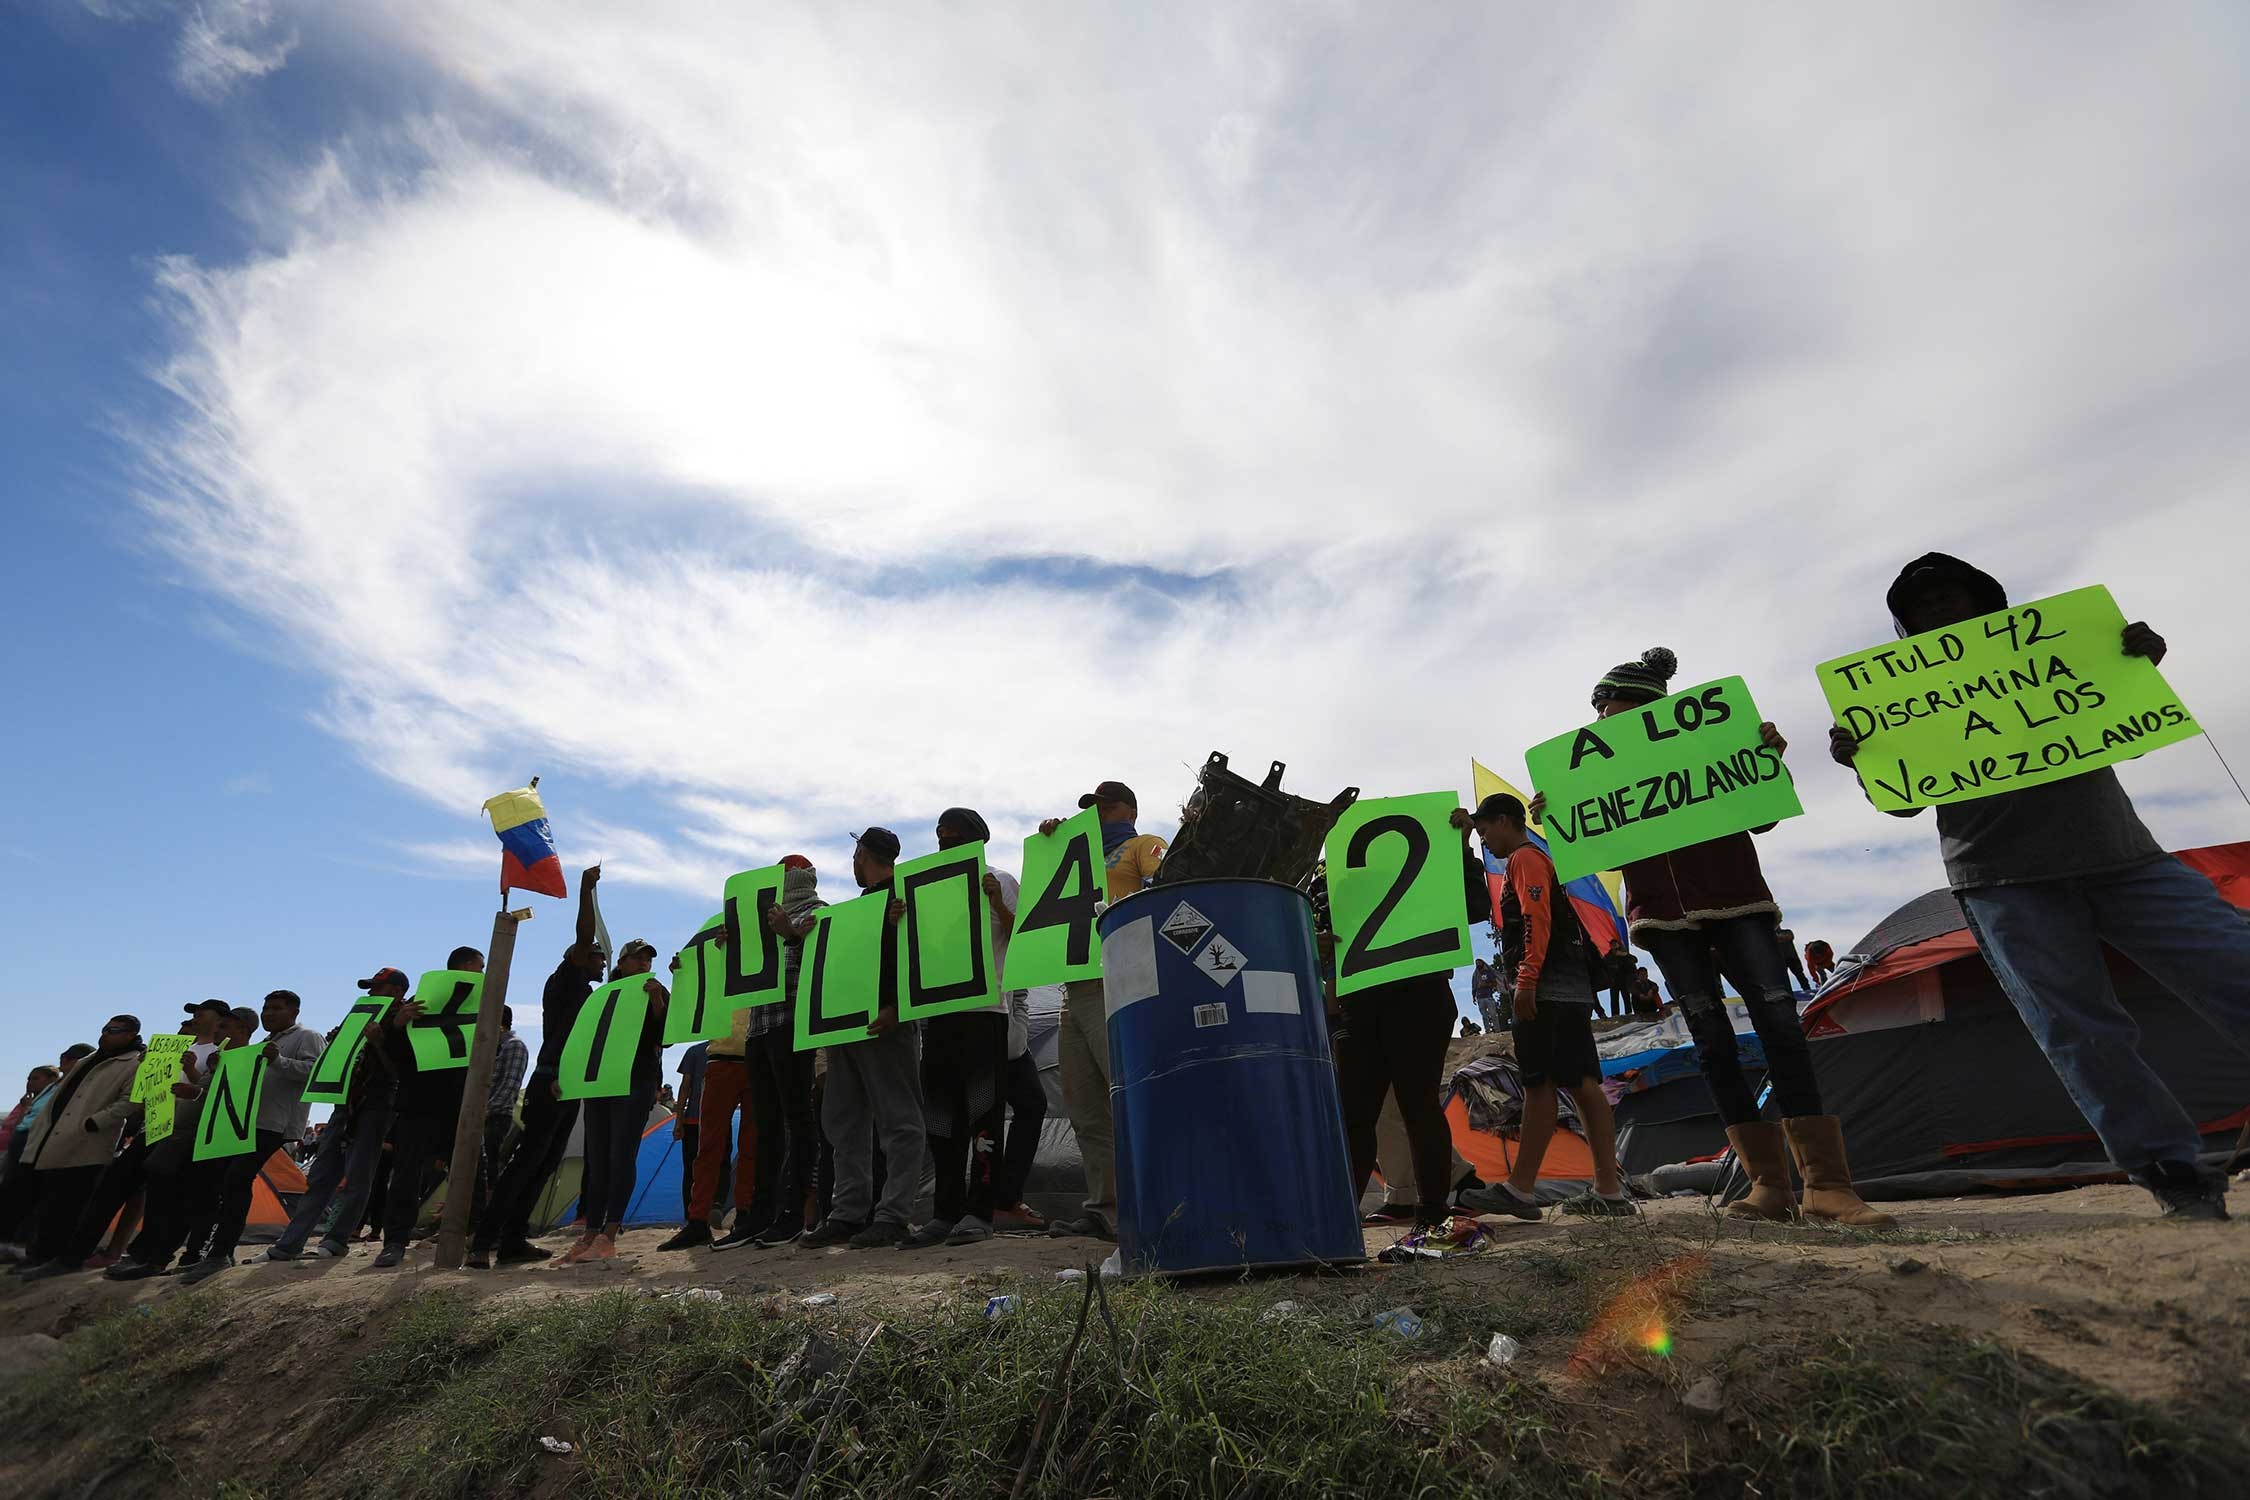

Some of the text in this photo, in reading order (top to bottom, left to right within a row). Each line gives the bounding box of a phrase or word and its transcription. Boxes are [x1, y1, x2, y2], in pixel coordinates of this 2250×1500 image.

[1984, 608, 2066, 651] 42
[1568, 686, 1731, 770] A LOS
[1964, 681, 2106, 740] A LOS
[1546, 745, 1780, 843] VENEZOLANOS
[1016, 831, 1104, 966] 4
[1340, 814, 1460, 978] 2
[204, 1054, 264, 1145] N
